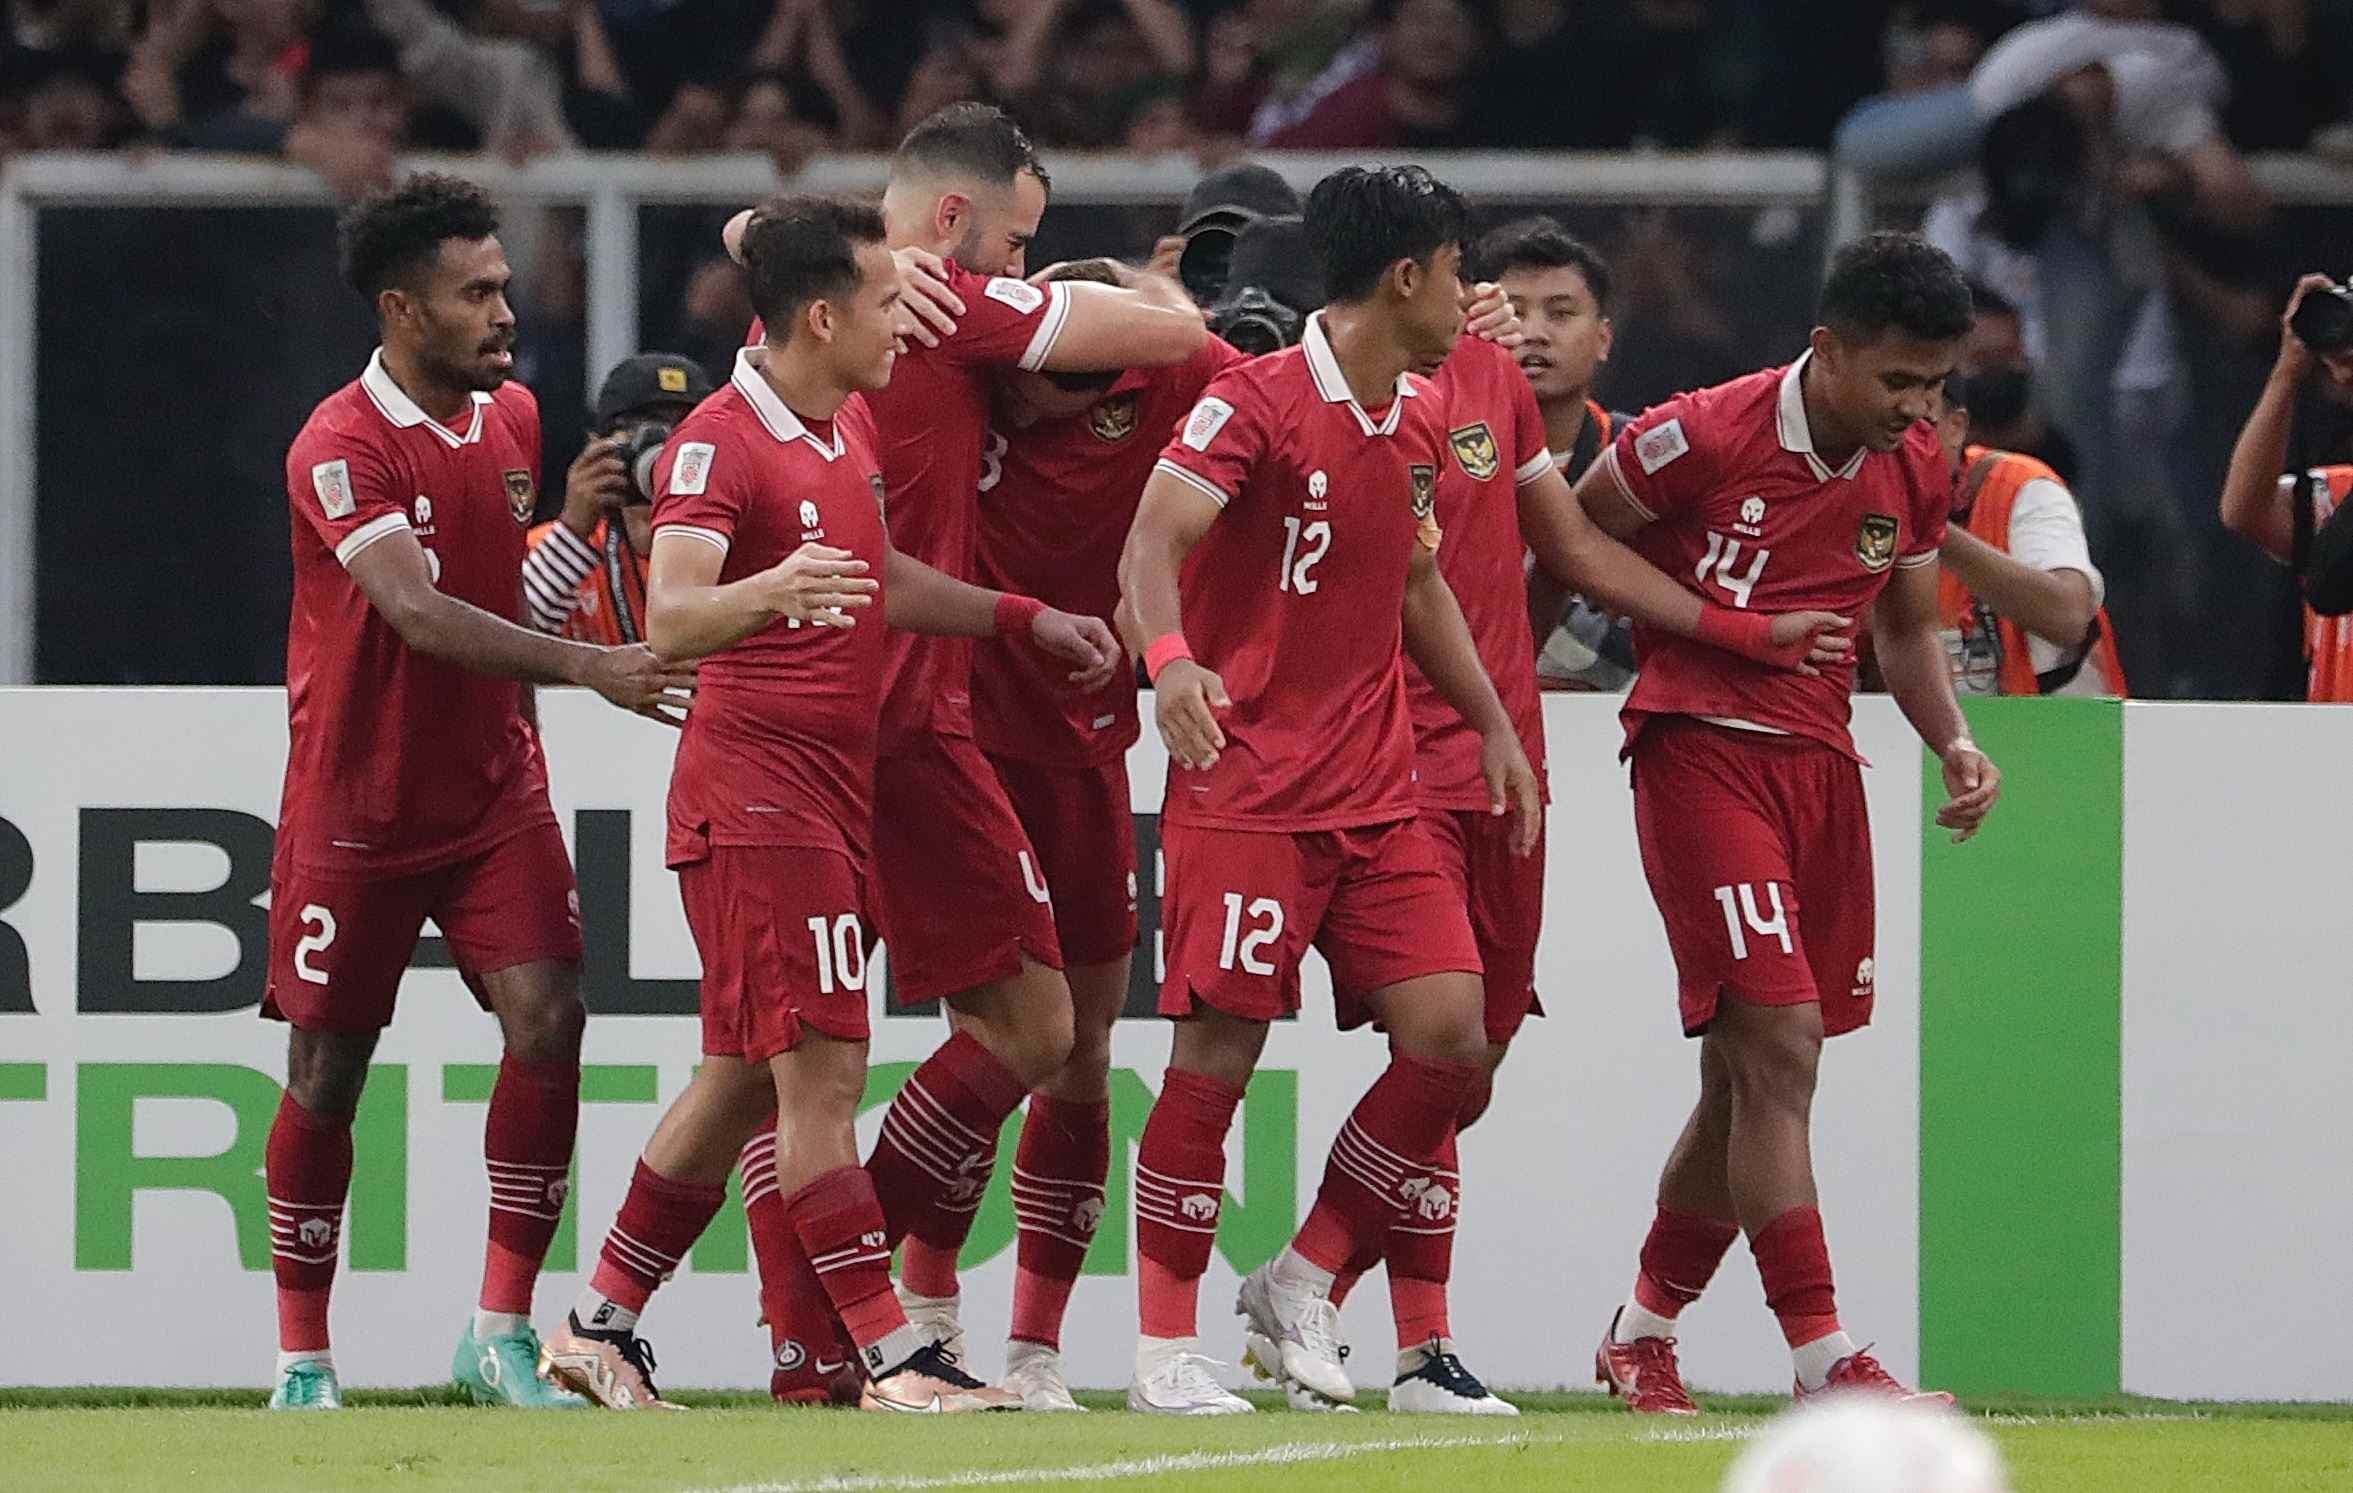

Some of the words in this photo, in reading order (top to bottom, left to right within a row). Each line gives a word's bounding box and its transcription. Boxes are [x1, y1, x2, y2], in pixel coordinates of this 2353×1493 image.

[1279, 516, 1331, 596] 12
[1694, 530, 1770, 609] 14
[294, 903, 338, 985] 2
[807, 913, 867, 995] 10
[1217, 892, 1285, 977] 12
[1714, 881, 1794, 960] 14
